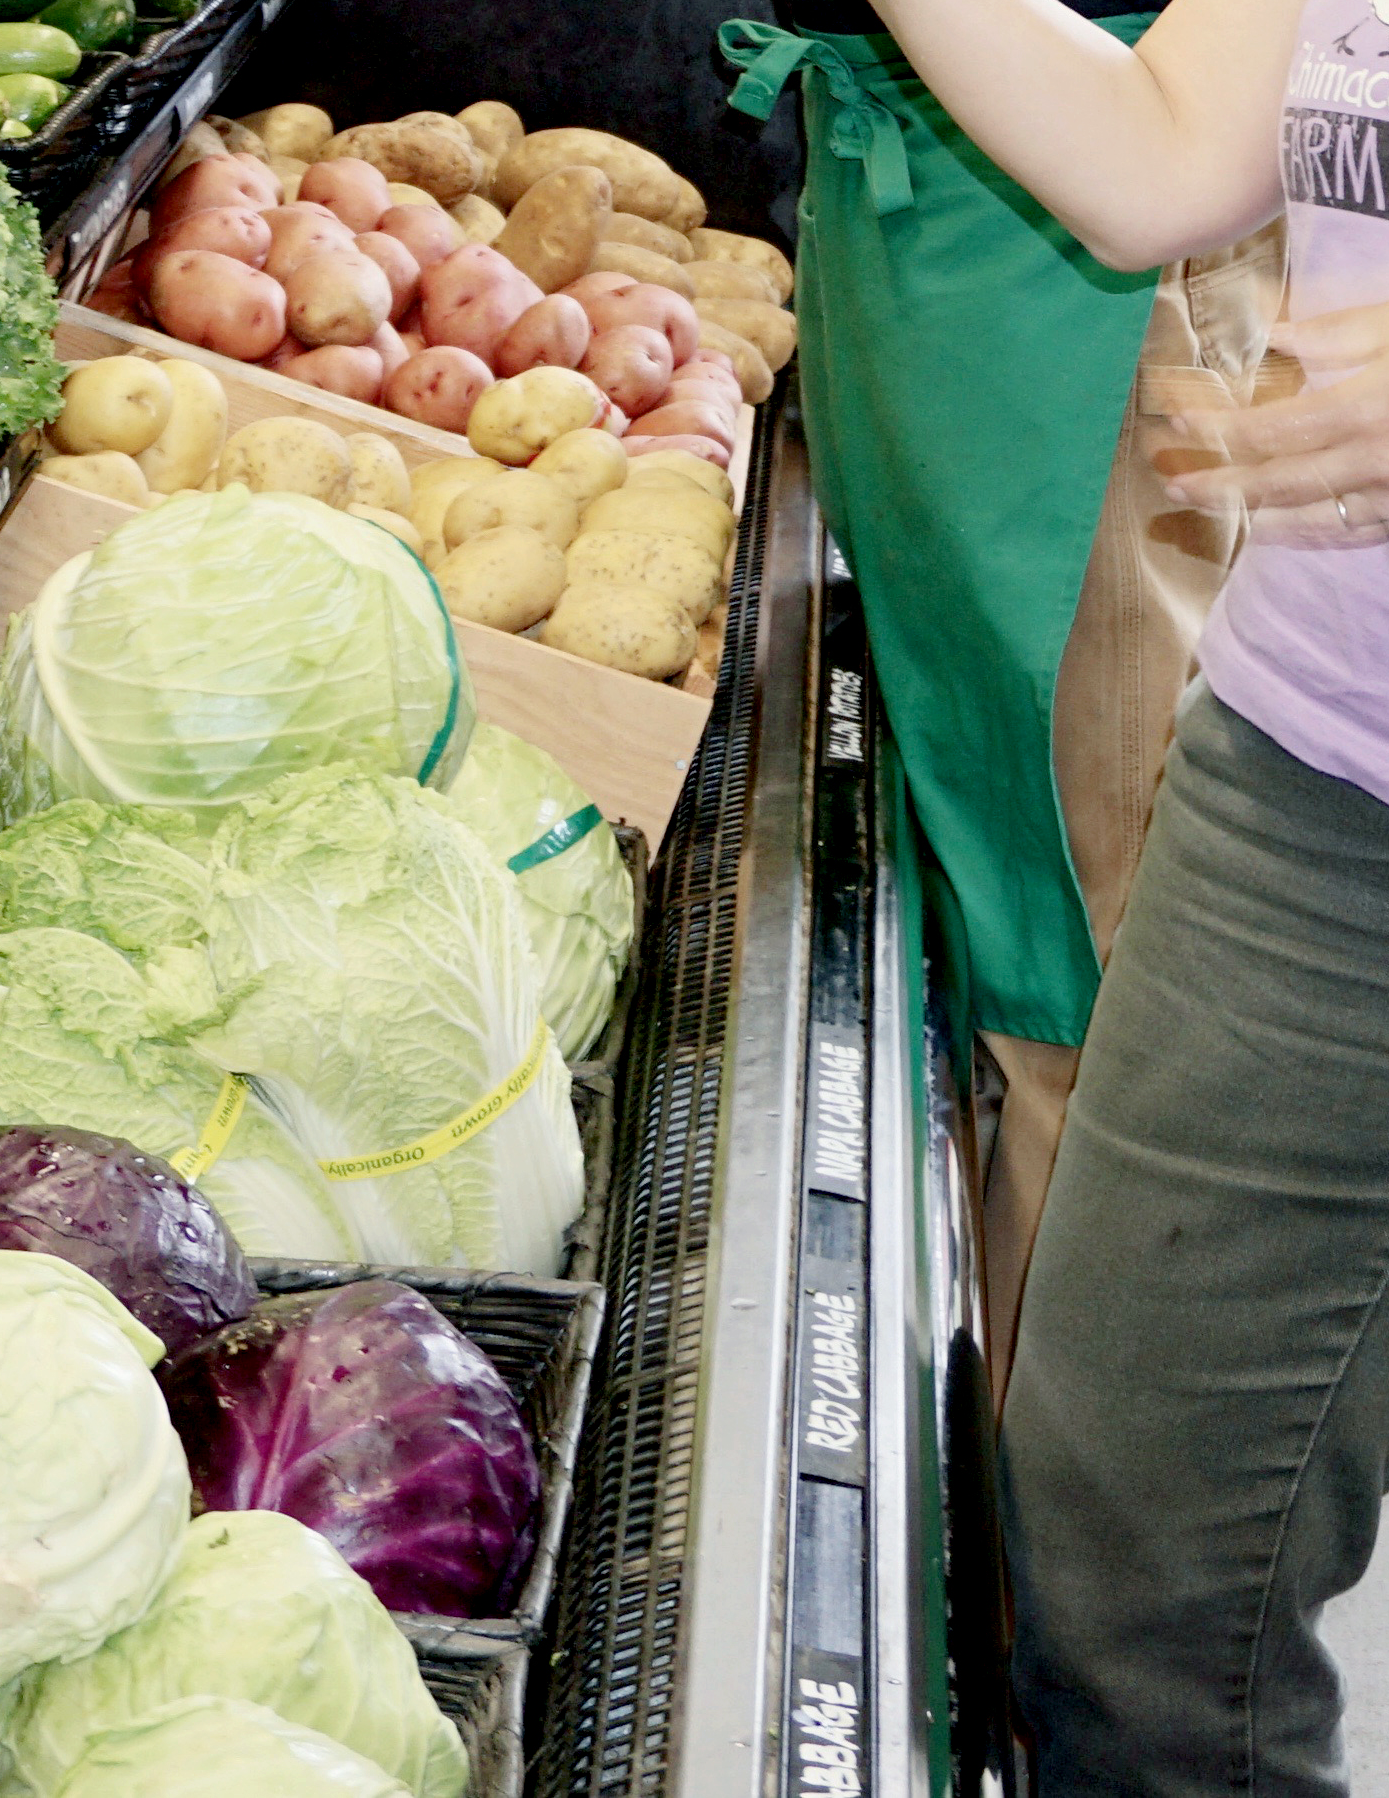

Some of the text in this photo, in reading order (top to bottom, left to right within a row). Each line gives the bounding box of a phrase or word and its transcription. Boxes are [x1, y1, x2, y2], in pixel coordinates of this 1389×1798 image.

[328, 1095, 504, 1178] Organically Grown
[814, 1041, 865, 1182] NAPA CABBAGE
[804, 1291, 861, 1453] RED CABBAGE
